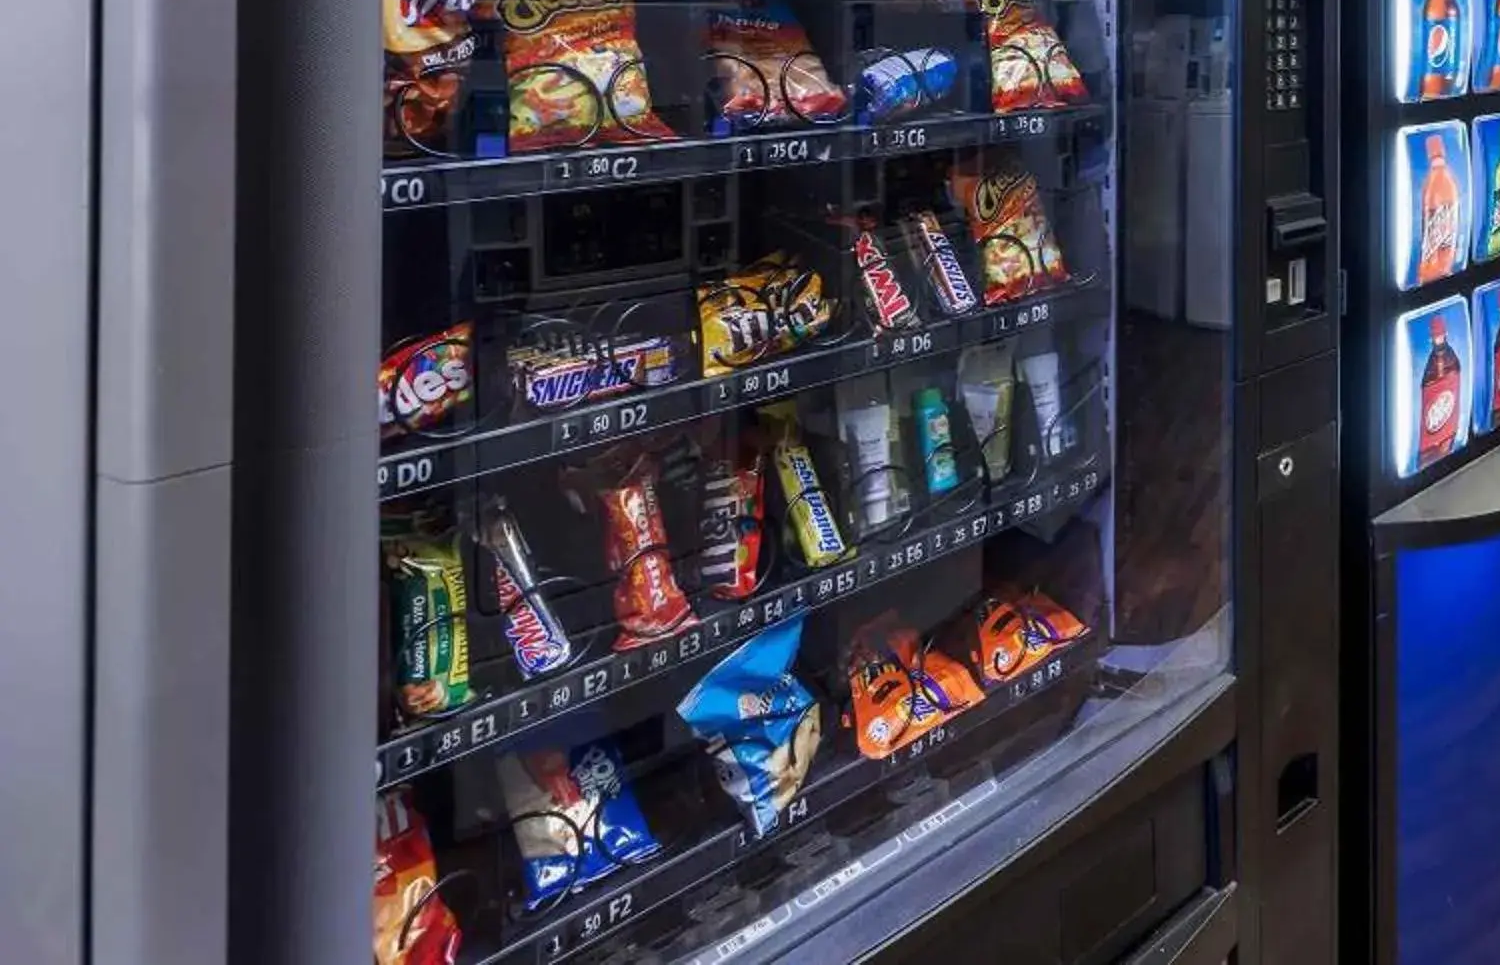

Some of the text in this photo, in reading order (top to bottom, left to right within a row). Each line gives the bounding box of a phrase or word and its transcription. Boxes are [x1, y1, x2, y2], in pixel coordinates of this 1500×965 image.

[787, 139, 809, 161] C4
[907, 127, 926, 148] C6
[612, 155, 638, 180] C2
[391, 177, 425, 204] C0
[911, 332, 932, 354] D6
[529, 356, 638, 406] SNICKERS
[766, 367, 789, 392] D4
[620, 404, 648, 430] D2
[397, 457, 433, 488] D0
[837, 569, 855, 593] E5
[763, 597, 784, 624] E4
[679, 631, 701, 658] E3
[584, 669, 608, 698] E2
[471, 713, 497, 744] E1
[788, 796, 808, 825] F4
[610, 892, 633, 924] F2
